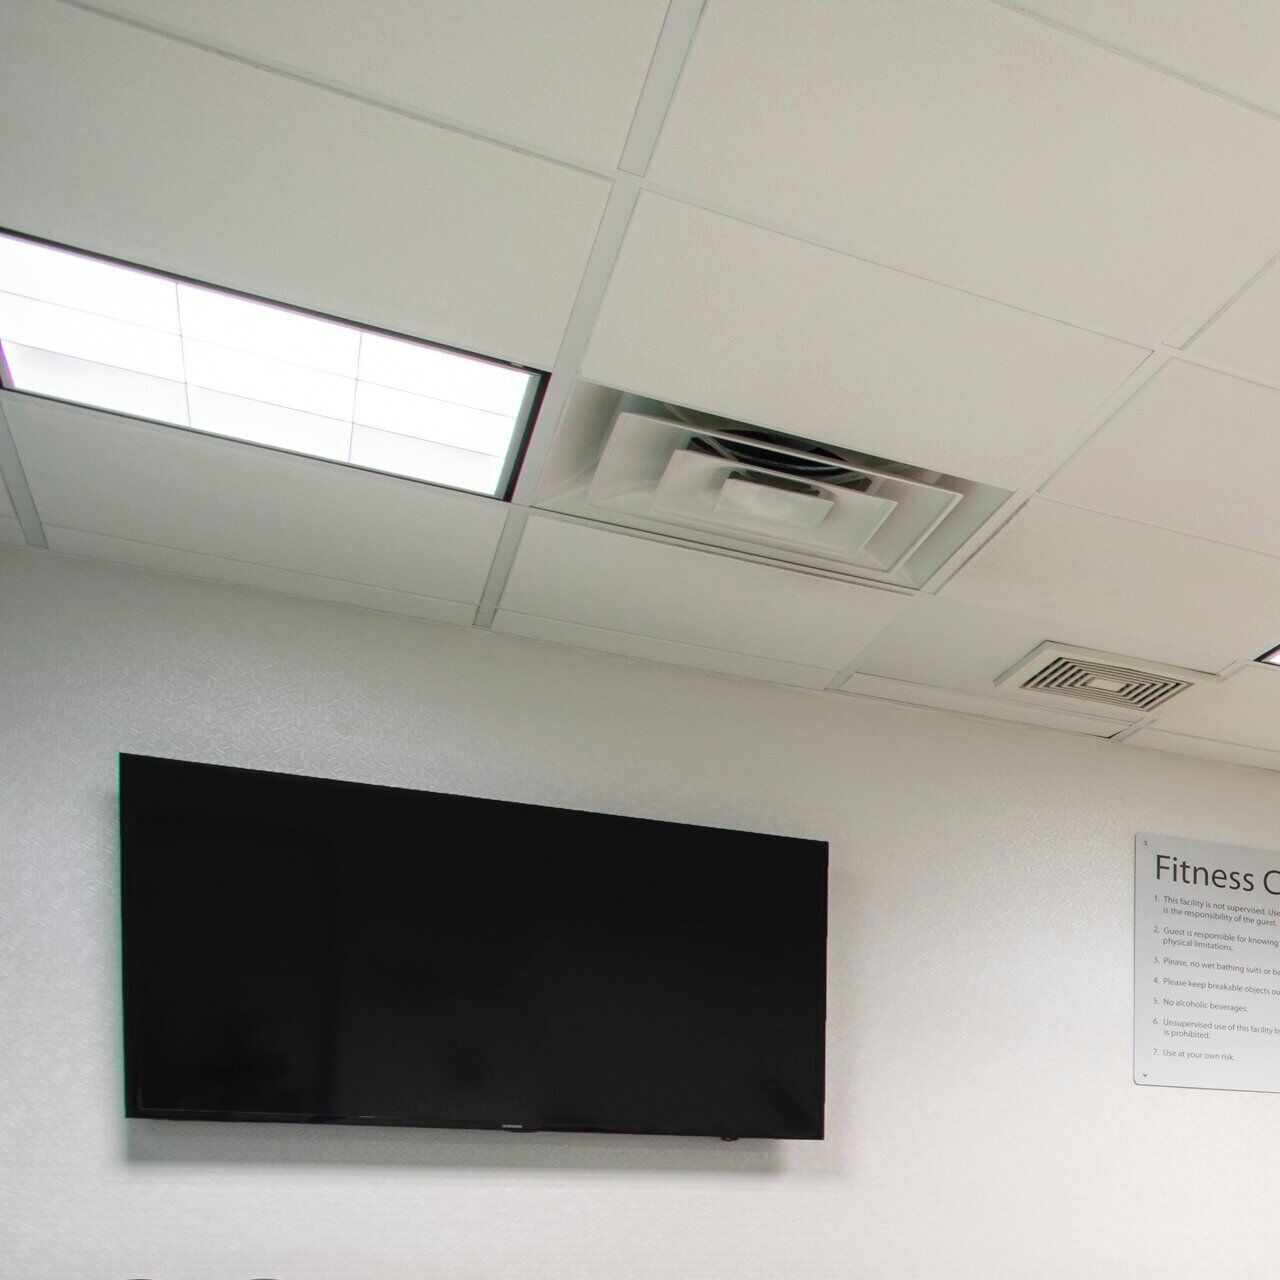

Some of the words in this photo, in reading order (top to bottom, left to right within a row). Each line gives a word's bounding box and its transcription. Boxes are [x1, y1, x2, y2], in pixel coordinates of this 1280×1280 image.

[1157, 854, 1254, 892] Fitness
[1164, 895, 1178, 904] This
[1180, 897, 1204, 908] facility
[1268, 909, 1280, 917] Use
[1163, 906, 1169, 914] is
[1170, 907, 1183, 915] the
[1184, 909, 1232, 923] responsibility
[1234, 914, 1242, 922] of
[1242, 915, 1254, 924] the
[1163, 927, 1185, 936] Guest
[1187, 929, 1193, 937] is
[1194, 931, 1235, 941] responsible
[1237, 934, 1246, 943] for
[1248, 936, 1278, 948] knowing
[1163, 938, 1192, 947] physical
[1216, 963, 1244, 973] bathing
[1246, 967, 1262, 975] suits
[1163, 977, 1187, 987] Please
[1188, 980, 1206, 990] keep
[1208, 981, 1243, 992] breakable
[1244, 986, 1270, 995] objects
[1175, 999, 1208, 1008] alcoholic
[1163, 1018, 1212, 1029] Unsupervised
[1227, 1023, 1235, 1031] of
[1236, 1024, 1249, 1032] this
[1250, 1025, 1272, 1035] facility
[1163, 1049, 1177, 1057] Use
